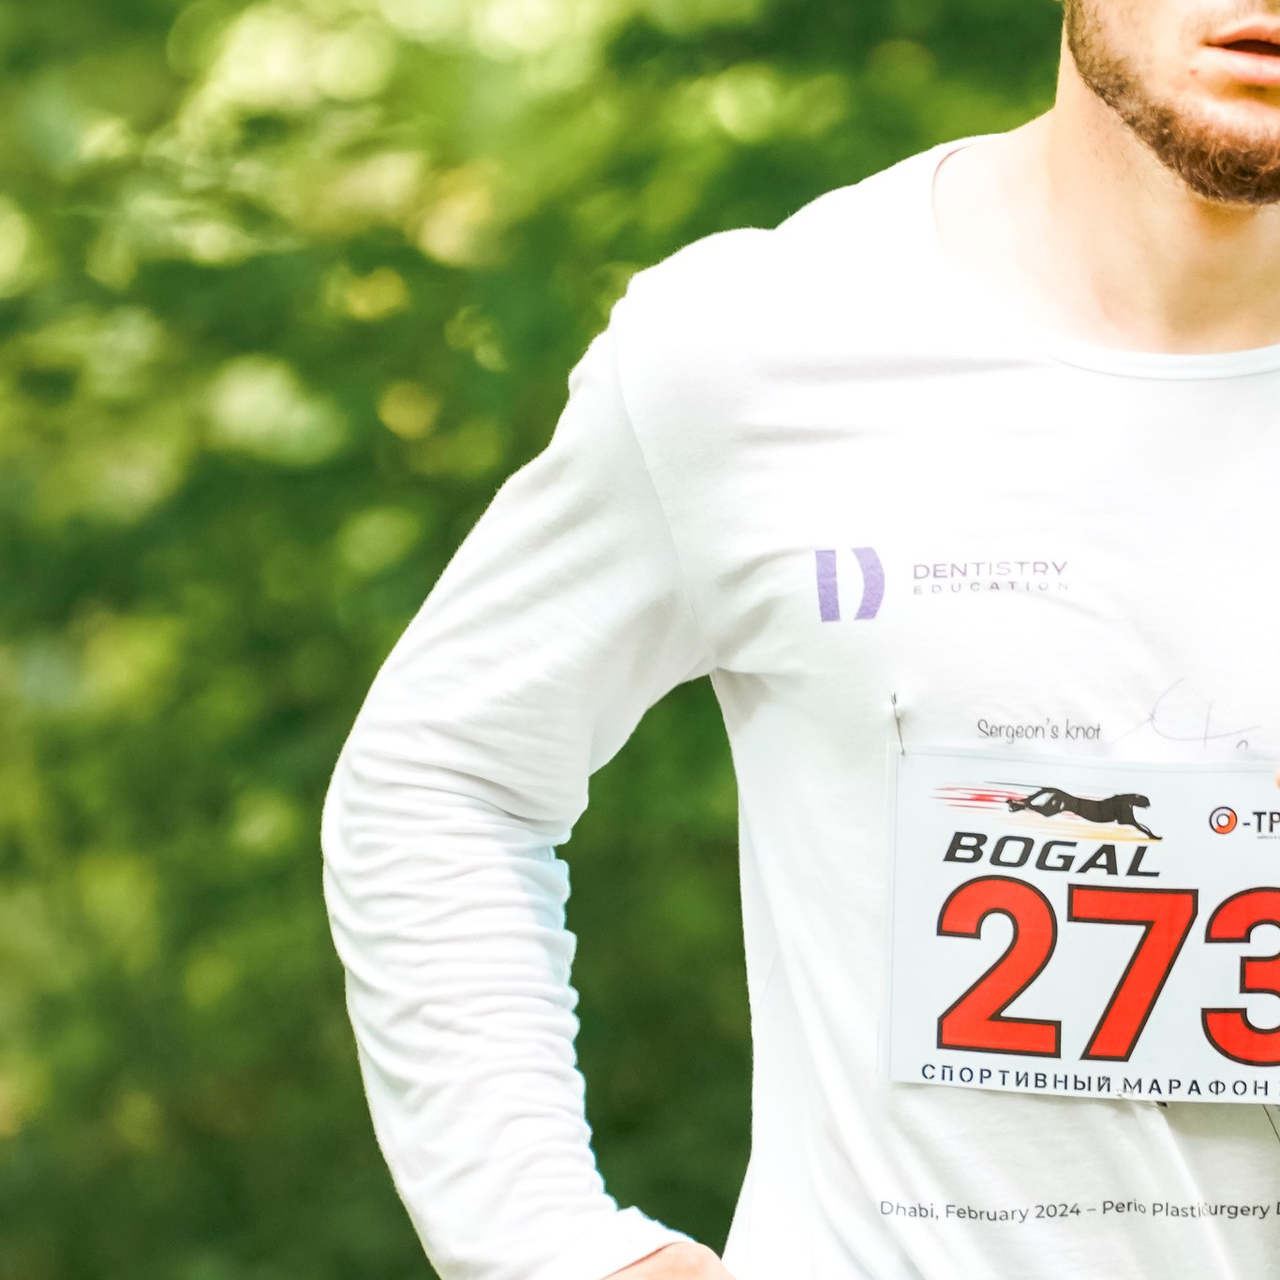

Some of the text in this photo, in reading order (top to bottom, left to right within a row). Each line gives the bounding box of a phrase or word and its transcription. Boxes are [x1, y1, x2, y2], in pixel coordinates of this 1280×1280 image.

[913, 561, 1069, 580] DENTISTRY
[913, 581, 1069, 596] EDUCATION
[1066, 718, 1101, 740] knot
[943, 831, 1161, 877] BOGAL
[921, 1063, 1111, 1093] СПОРТИВНЫЙ
[1123, 1077, 1269, 1096] МАРАФОН
[880, 1201, 939, 1221] Dhabi,
[945, 1204, 1029, 1224] February
[1034, 1202, 1081, 1219] 2024
[1102, 1198, 1147, 1215] Perio
